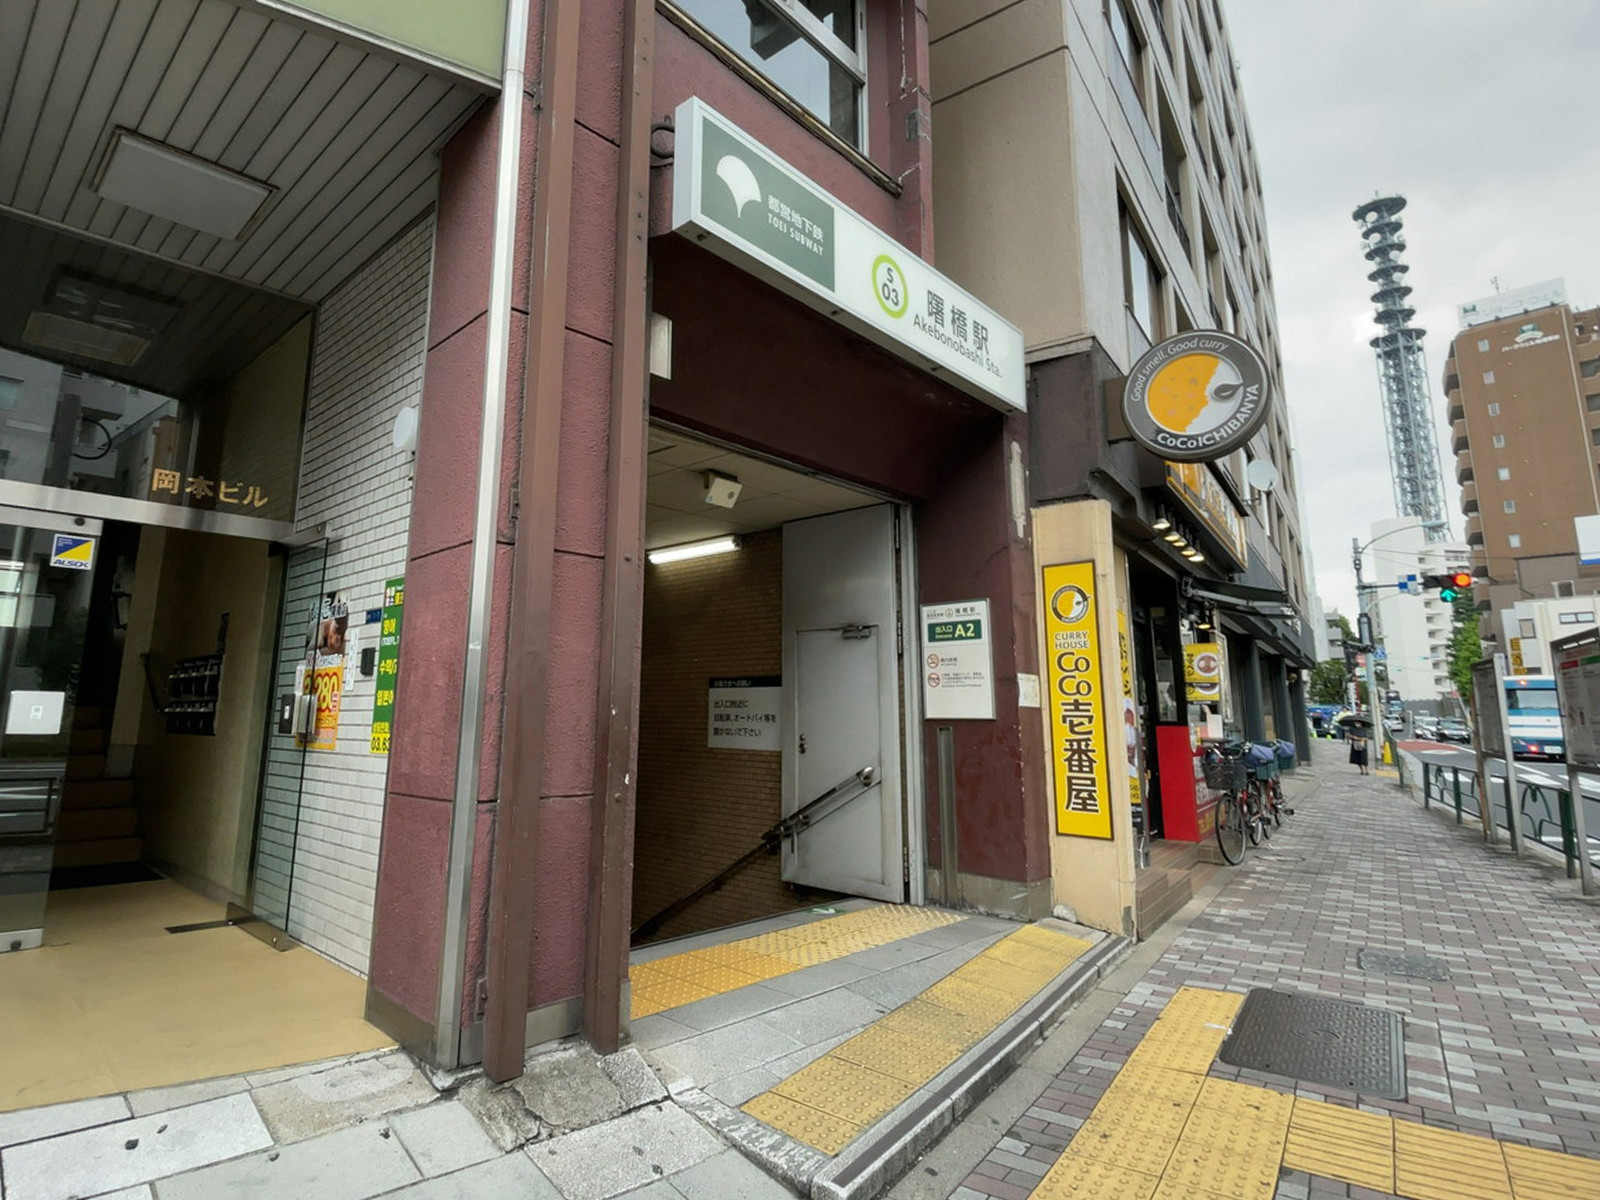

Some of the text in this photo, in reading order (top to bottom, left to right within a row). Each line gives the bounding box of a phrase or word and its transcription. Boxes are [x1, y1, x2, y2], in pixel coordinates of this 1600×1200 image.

[767, 212, 824, 257] TOEI SUBWAY
[886, 267, 894, 284] S
[881, 282, 899, 307] 03
[927, 289, 989, 355] 曙橋駅
[913, 313, 1003, 378] Akebonobashi Sta.
[1131, 374, 1146, 402] Good
[1167, 337, 1199, 355] Good
[1199, 339, 1229, 353] curry
[152, 468, 269, 508] 岡本ビル
[53, 559, 90, 568] ALSOK
[955, 622, 975, 637] A2
[1055, 631, 1088, 641] CURRY
[1055, 640, 1089, 649] HOUSE
